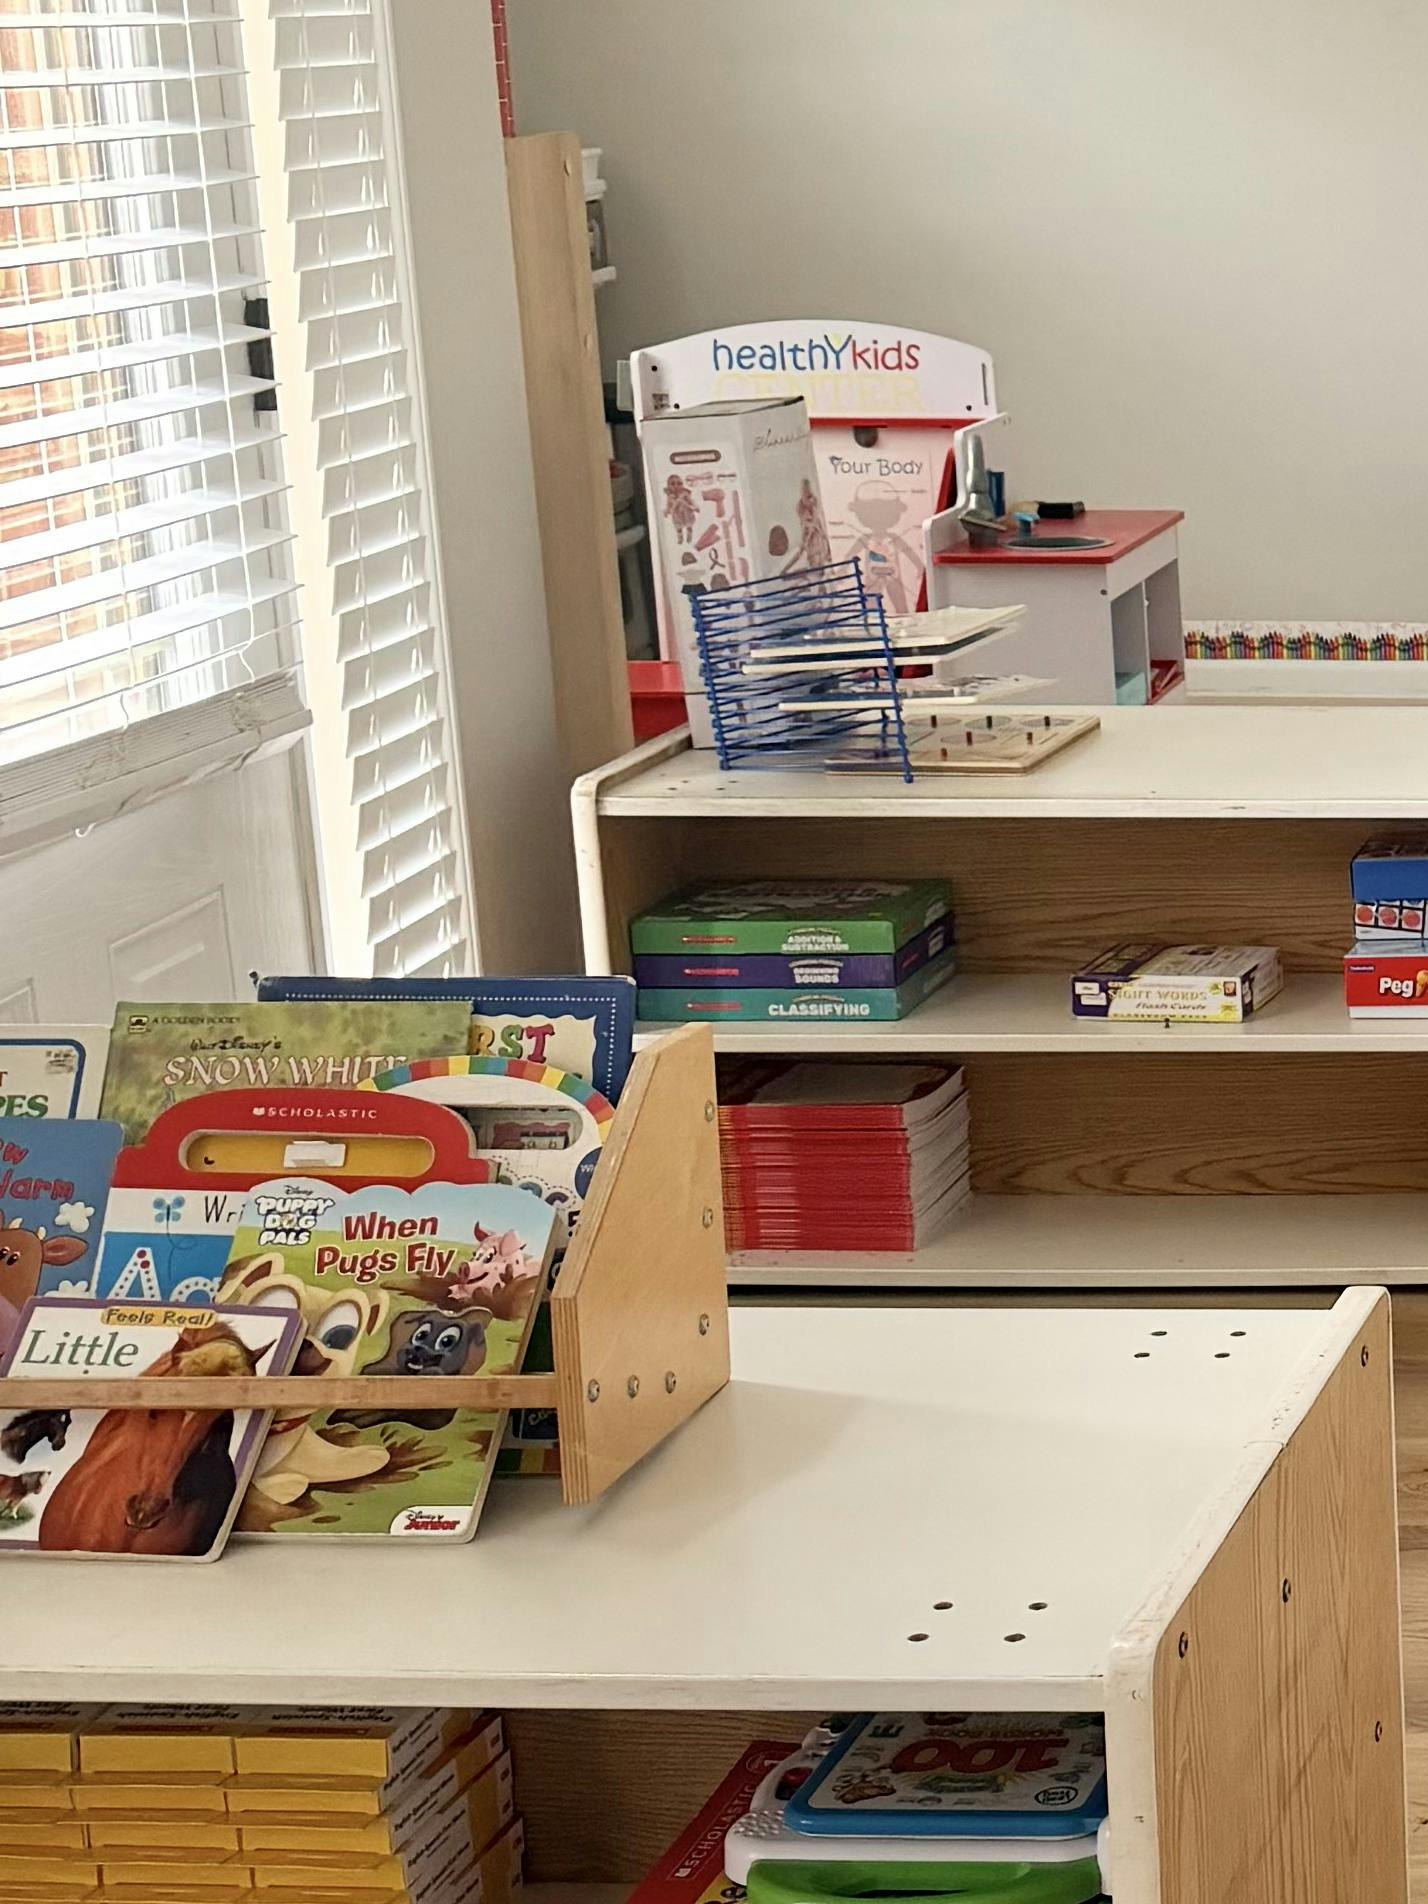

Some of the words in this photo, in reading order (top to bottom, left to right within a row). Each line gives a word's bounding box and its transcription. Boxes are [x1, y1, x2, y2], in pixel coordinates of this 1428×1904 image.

[828, 455, 872, 475] Your
[878, 457, 924, 477] Body
[1379, 977, 1414, 998] Peg
[768, 1003, 871, 1017] CLASSIFYING
[190, 1038, 220, 1052] Walt
[220, 1036, 282, 1052] Disney's
[163, 1054, 280, 1086] SNOW
[267, 1106, 378, 1119] SCHOLASTIC
[284, 1185, 313, 1196] Disney
[255, 1195, 335, 1217] PUPPY
[263, 1213, 318, 1230] DOG
[343, 1211, 439, 1242] When
[258, 1231, 312, 1246] PALS
[315, 1246, 399, 1285] Pugs
[406, 1242, 455, 1277] Fly
[106, 1308, 155, 1325] Feels
[21, 1329, 139, 1367] Little
[891, 1738, 1069, 1774] 100
[687, 1784, 755, 1871] SCHOLASTIC
